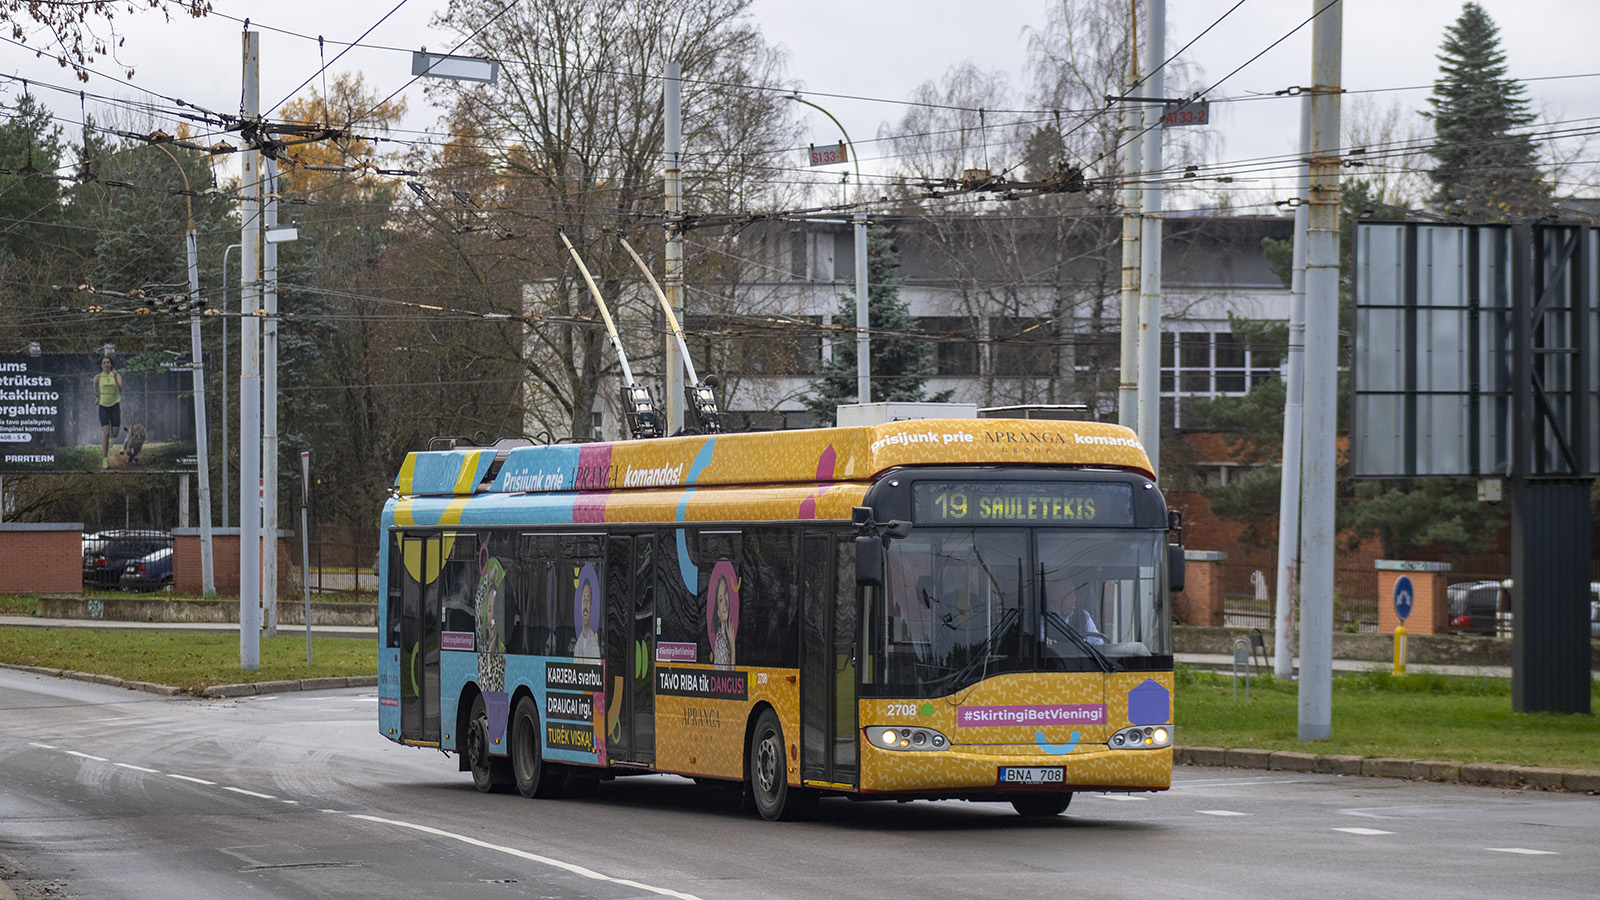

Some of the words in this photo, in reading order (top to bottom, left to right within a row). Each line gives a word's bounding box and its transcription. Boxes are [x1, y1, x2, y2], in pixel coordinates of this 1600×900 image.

[1179, 110, 1205, 123] 33-2
[812, 152, 822, 164] SI
[824, 150, 845, 162] 33-1
[942, 430, 974, 445] prie
[985, 431, 1065, 444] APRANGA
[567, 464, 619, 489] APRANGA
[624, 462, 684, 488] komandos!
[935, 492, 967, 518] 19
[547, 667, 577, 685] KARJERA
[578, 669, 602, 686] svarbu.
[660, 672, 679, 690] TAVO
[680, 674, 697, 692] RIBA
[699, 673, 709, 692] tik
[710, 676, 744, 695] DANGUS!
[548, 697, 577, 715] DRAUGAI
[578, 698, 592, 719] irgi.
[682, 707, 720, 728] APRANGA
[887, 704, 917, 716] 2708
[964, 707, 1103, 723] #SkirtingiBetVieningi
[548, 725, 569, 745] TURĖK
[570, 730, 592, 751] VISKĄ!
[1007, 770, 1031, 780] BNA
[1040, 769, 1061, 781] 708
